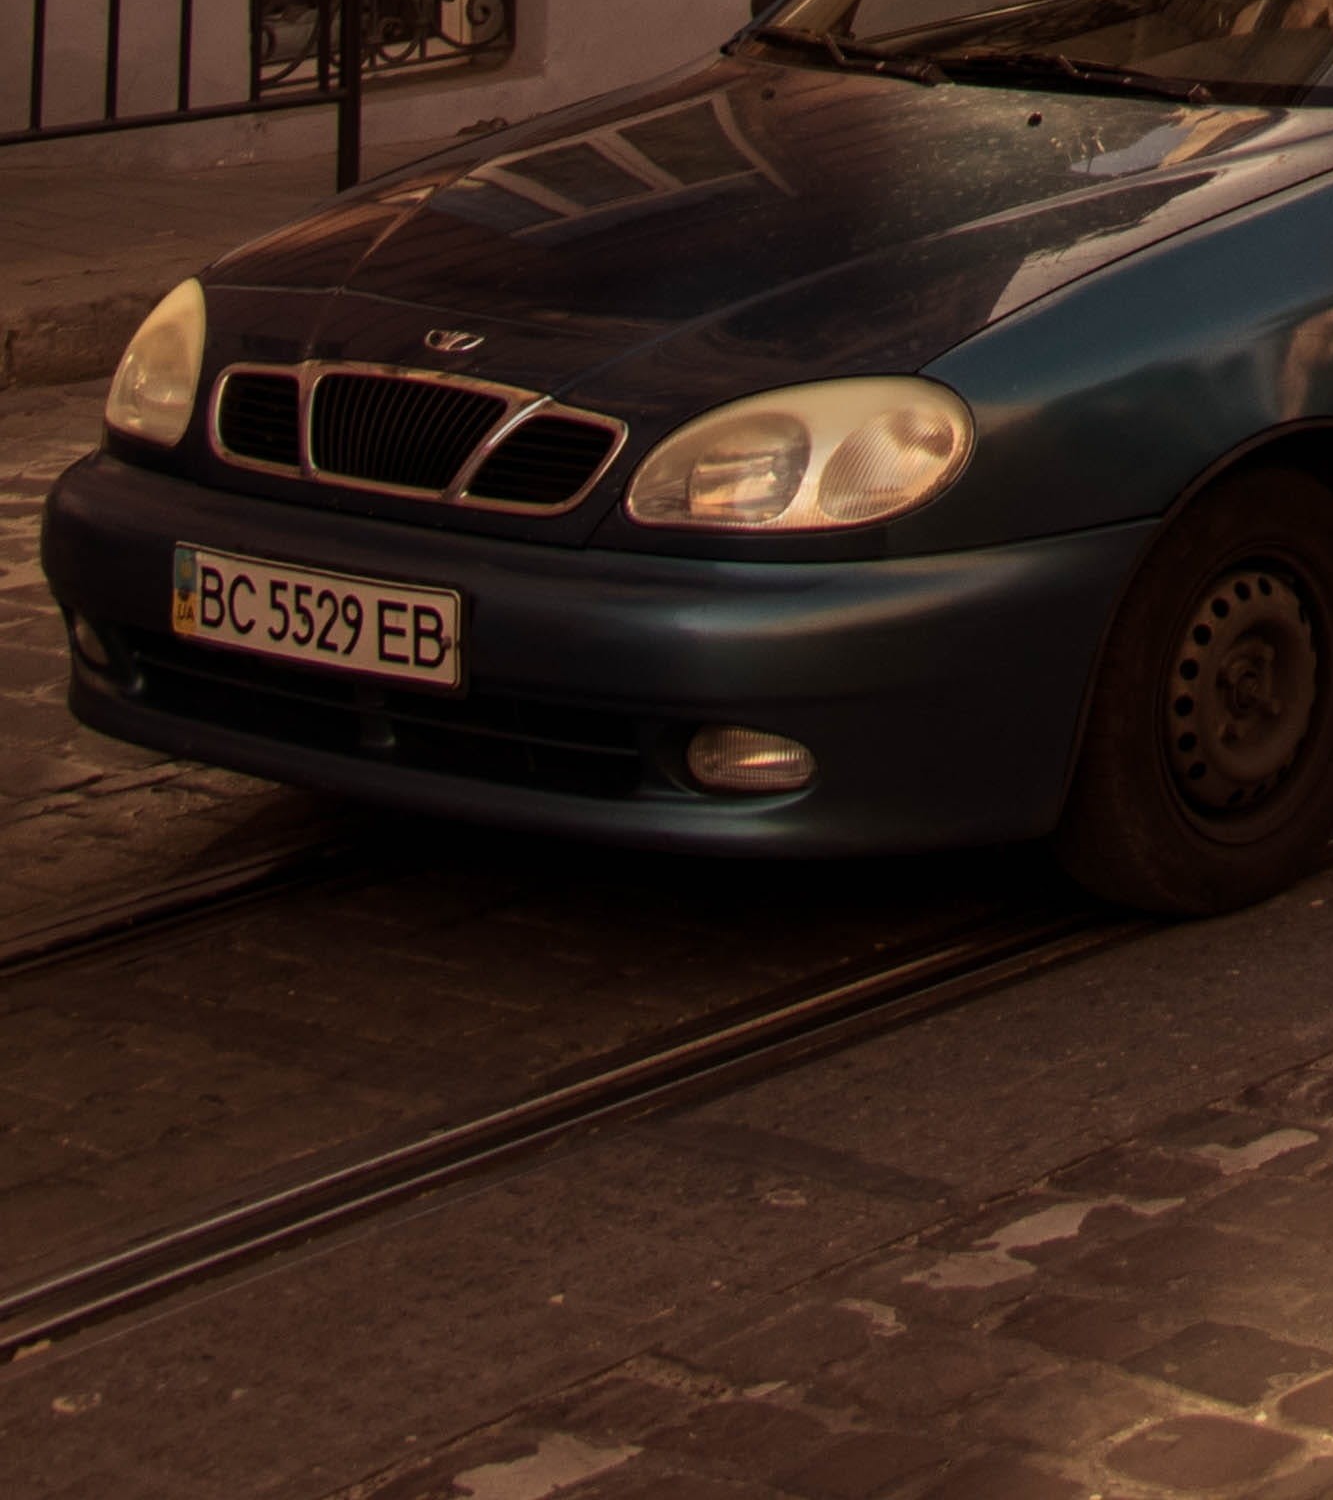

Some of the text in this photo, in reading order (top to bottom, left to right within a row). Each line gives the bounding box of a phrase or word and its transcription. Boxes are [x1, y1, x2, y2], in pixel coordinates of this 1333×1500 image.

[201, 566, 447, 668] BC 5529 EB
